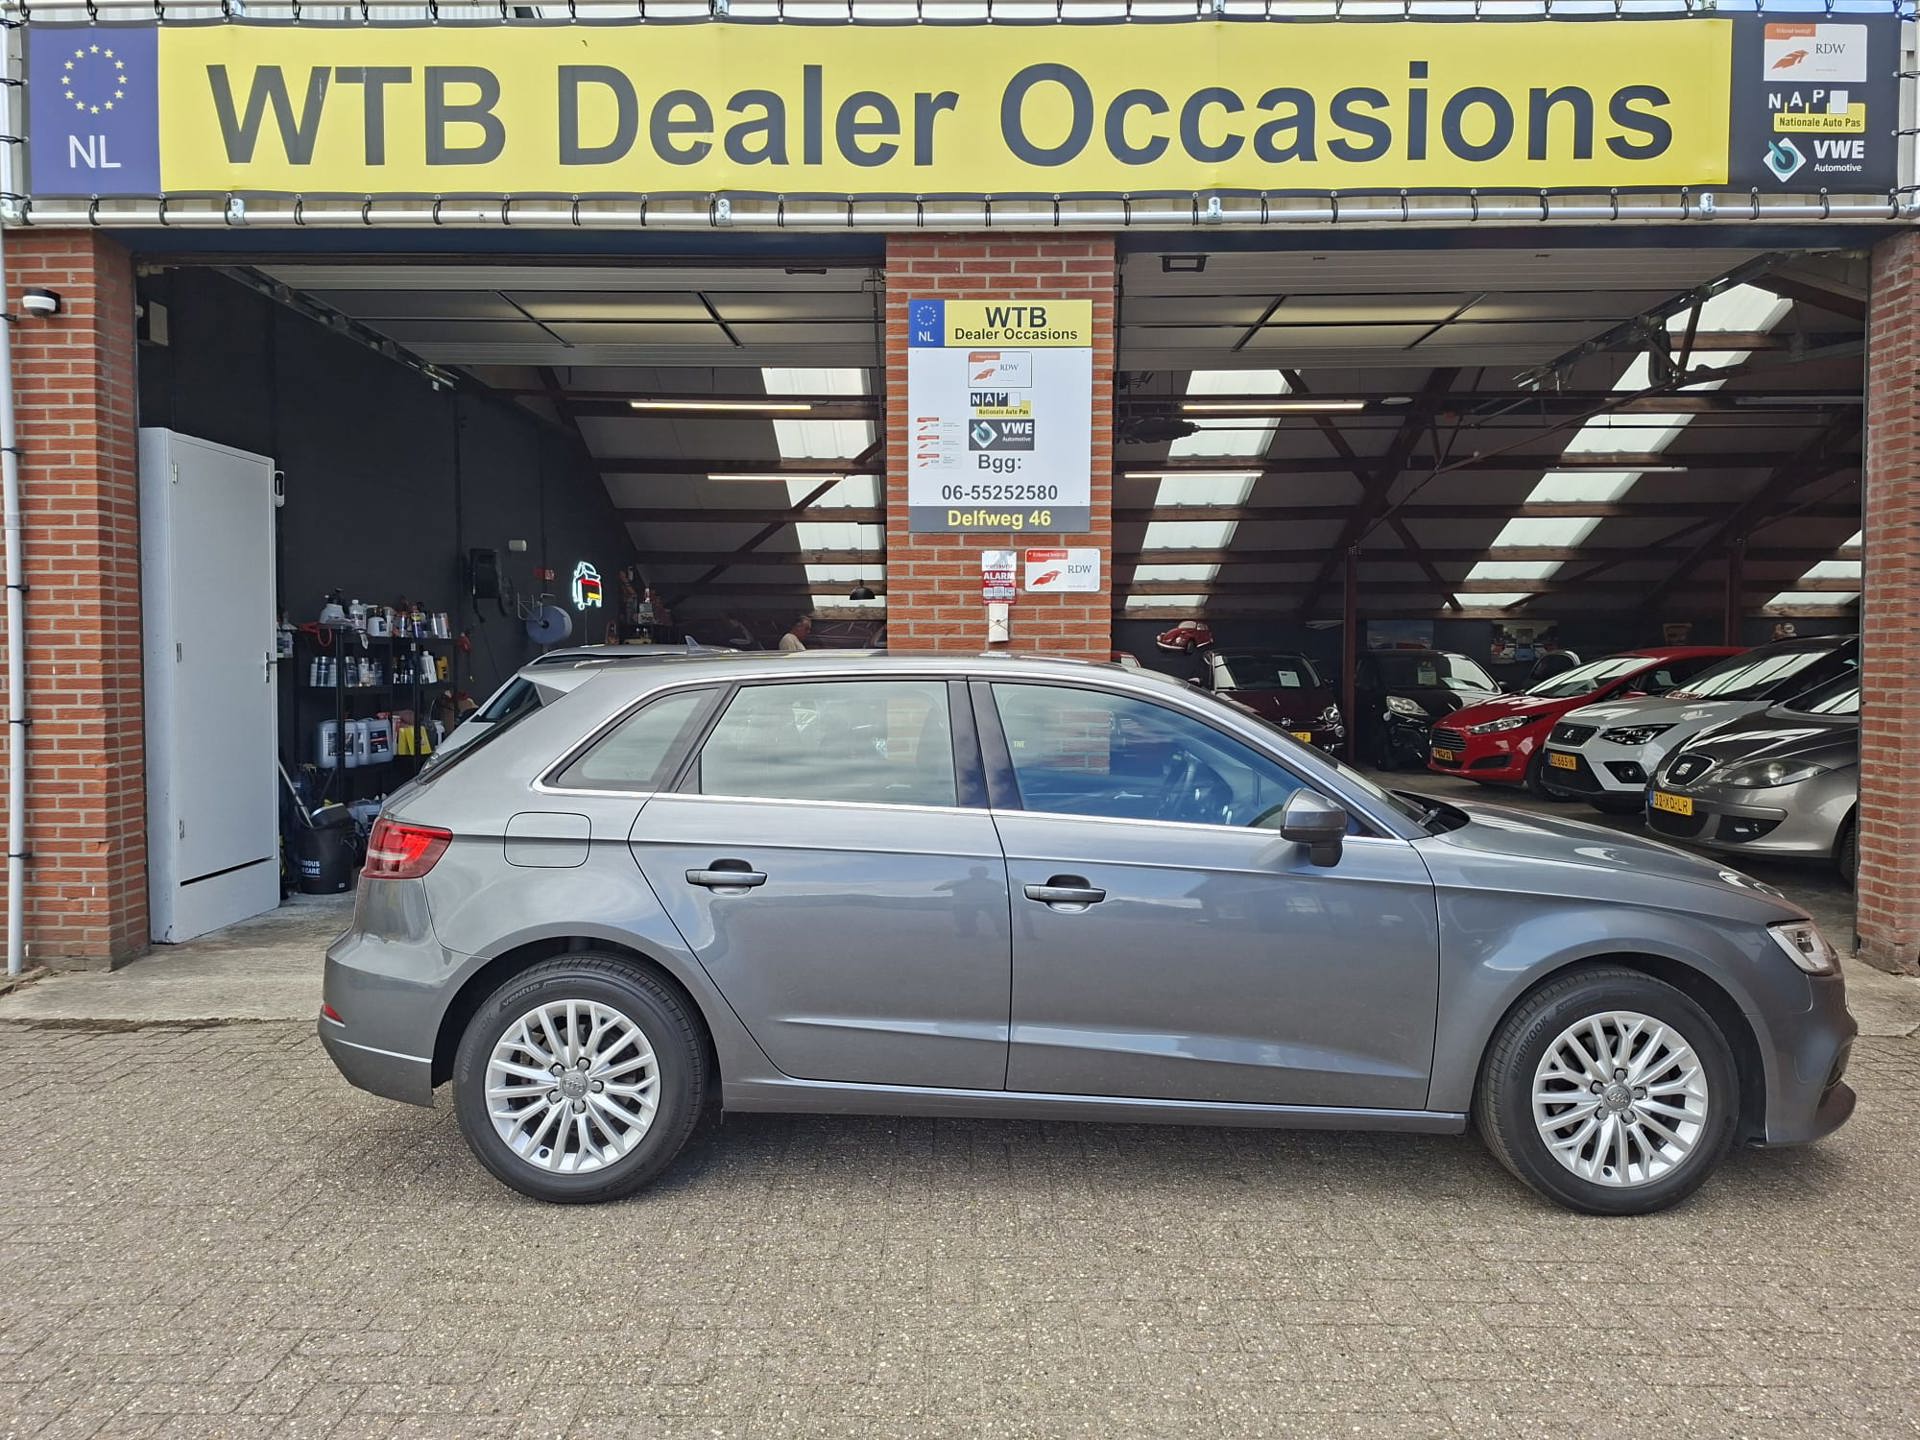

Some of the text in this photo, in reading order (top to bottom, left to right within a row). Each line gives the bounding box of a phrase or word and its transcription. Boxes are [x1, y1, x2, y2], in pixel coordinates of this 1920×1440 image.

[1815, 43, 1846, 54] RDW
[206, 59, 1673, 167] WTB Dealer Occasions
[1779, 117, 1861, 127] Nationale Auto Pas
[68, 135, 121, 169] NL
[1813, 140, 1865, 159] VWE
[1814, 163, 1862, 173] Automotive
[985, 306, 1047, 328] WTB
[918, 331, 934, 342] NL
[955, 328, 1078, 340] Dealer Occasions
[1000, 363, 1019, 371] RDW
[1001, 422, 1033, 434] VWE
[978, 454, 1022, 474] Bgg:
[942, 485, 1058, 500] 06-55252580
[947, 510, 1052, 529] Delfweg 46
[1067, 564, 1092, 574] RDW
[983, 571, 1016, 581] ALARM
